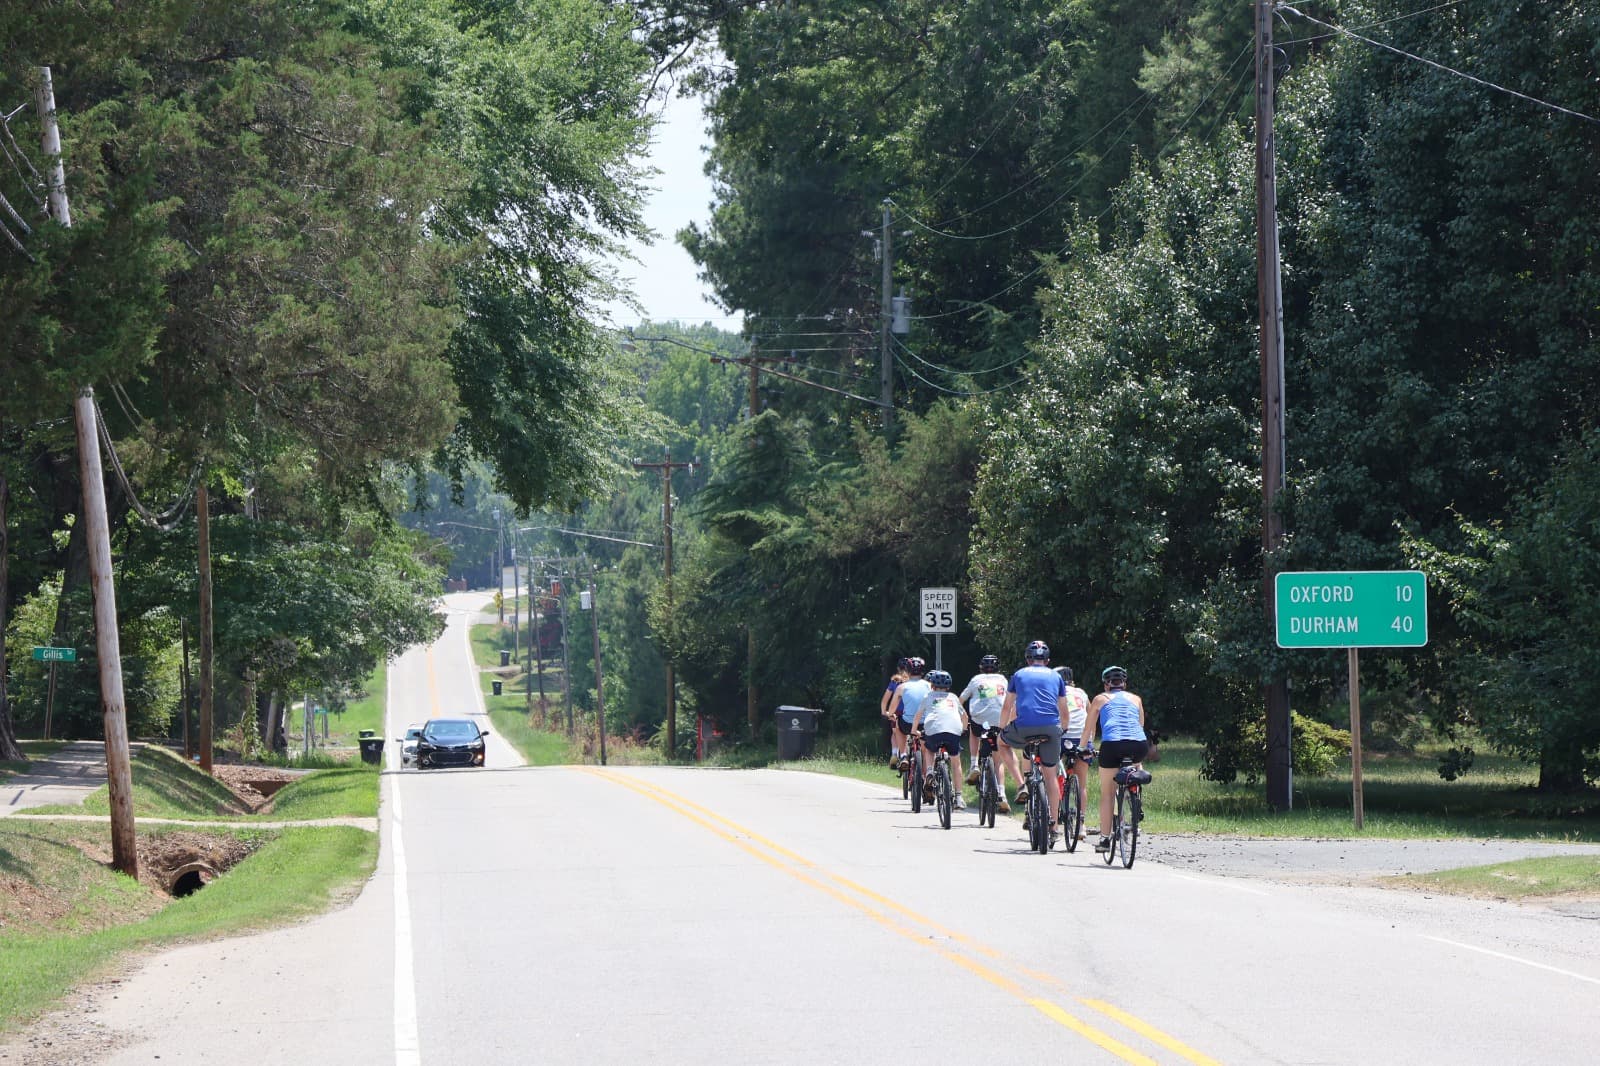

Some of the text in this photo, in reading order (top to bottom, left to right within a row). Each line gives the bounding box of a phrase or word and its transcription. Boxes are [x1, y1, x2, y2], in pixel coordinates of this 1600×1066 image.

[1290, 585, 1412, 603] OXFORD 10
[924, 612, 953, 627] 35
[1290, 615, 1413, 634] DURHAM 40
[43, 649, 63, 659] Gillis
